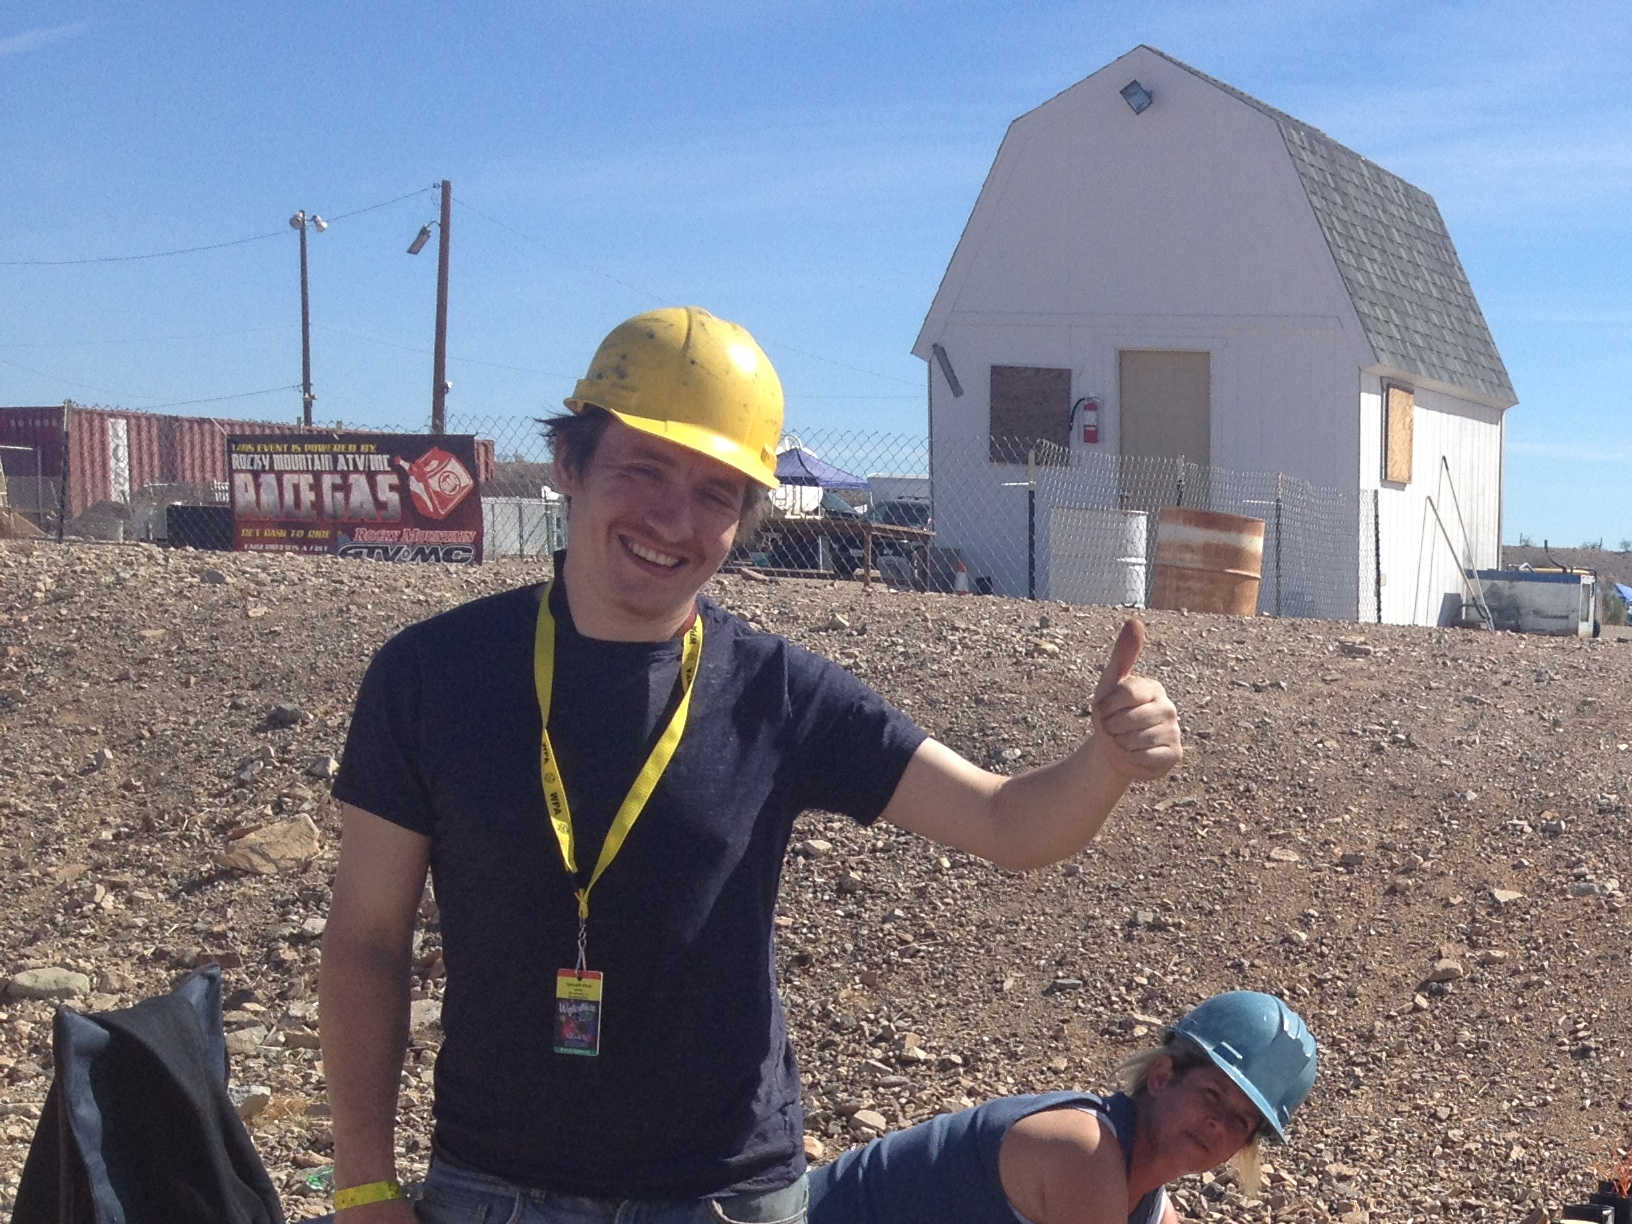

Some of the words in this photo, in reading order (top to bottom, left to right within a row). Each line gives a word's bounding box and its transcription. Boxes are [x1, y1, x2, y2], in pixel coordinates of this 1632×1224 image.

[257, 444, 288, 452] EVENT
[305, 444, 357, 452] POWERED
[232, 454, 270, 470] ROCKY
[273, 454, 333, 471] MOUNTAIN
